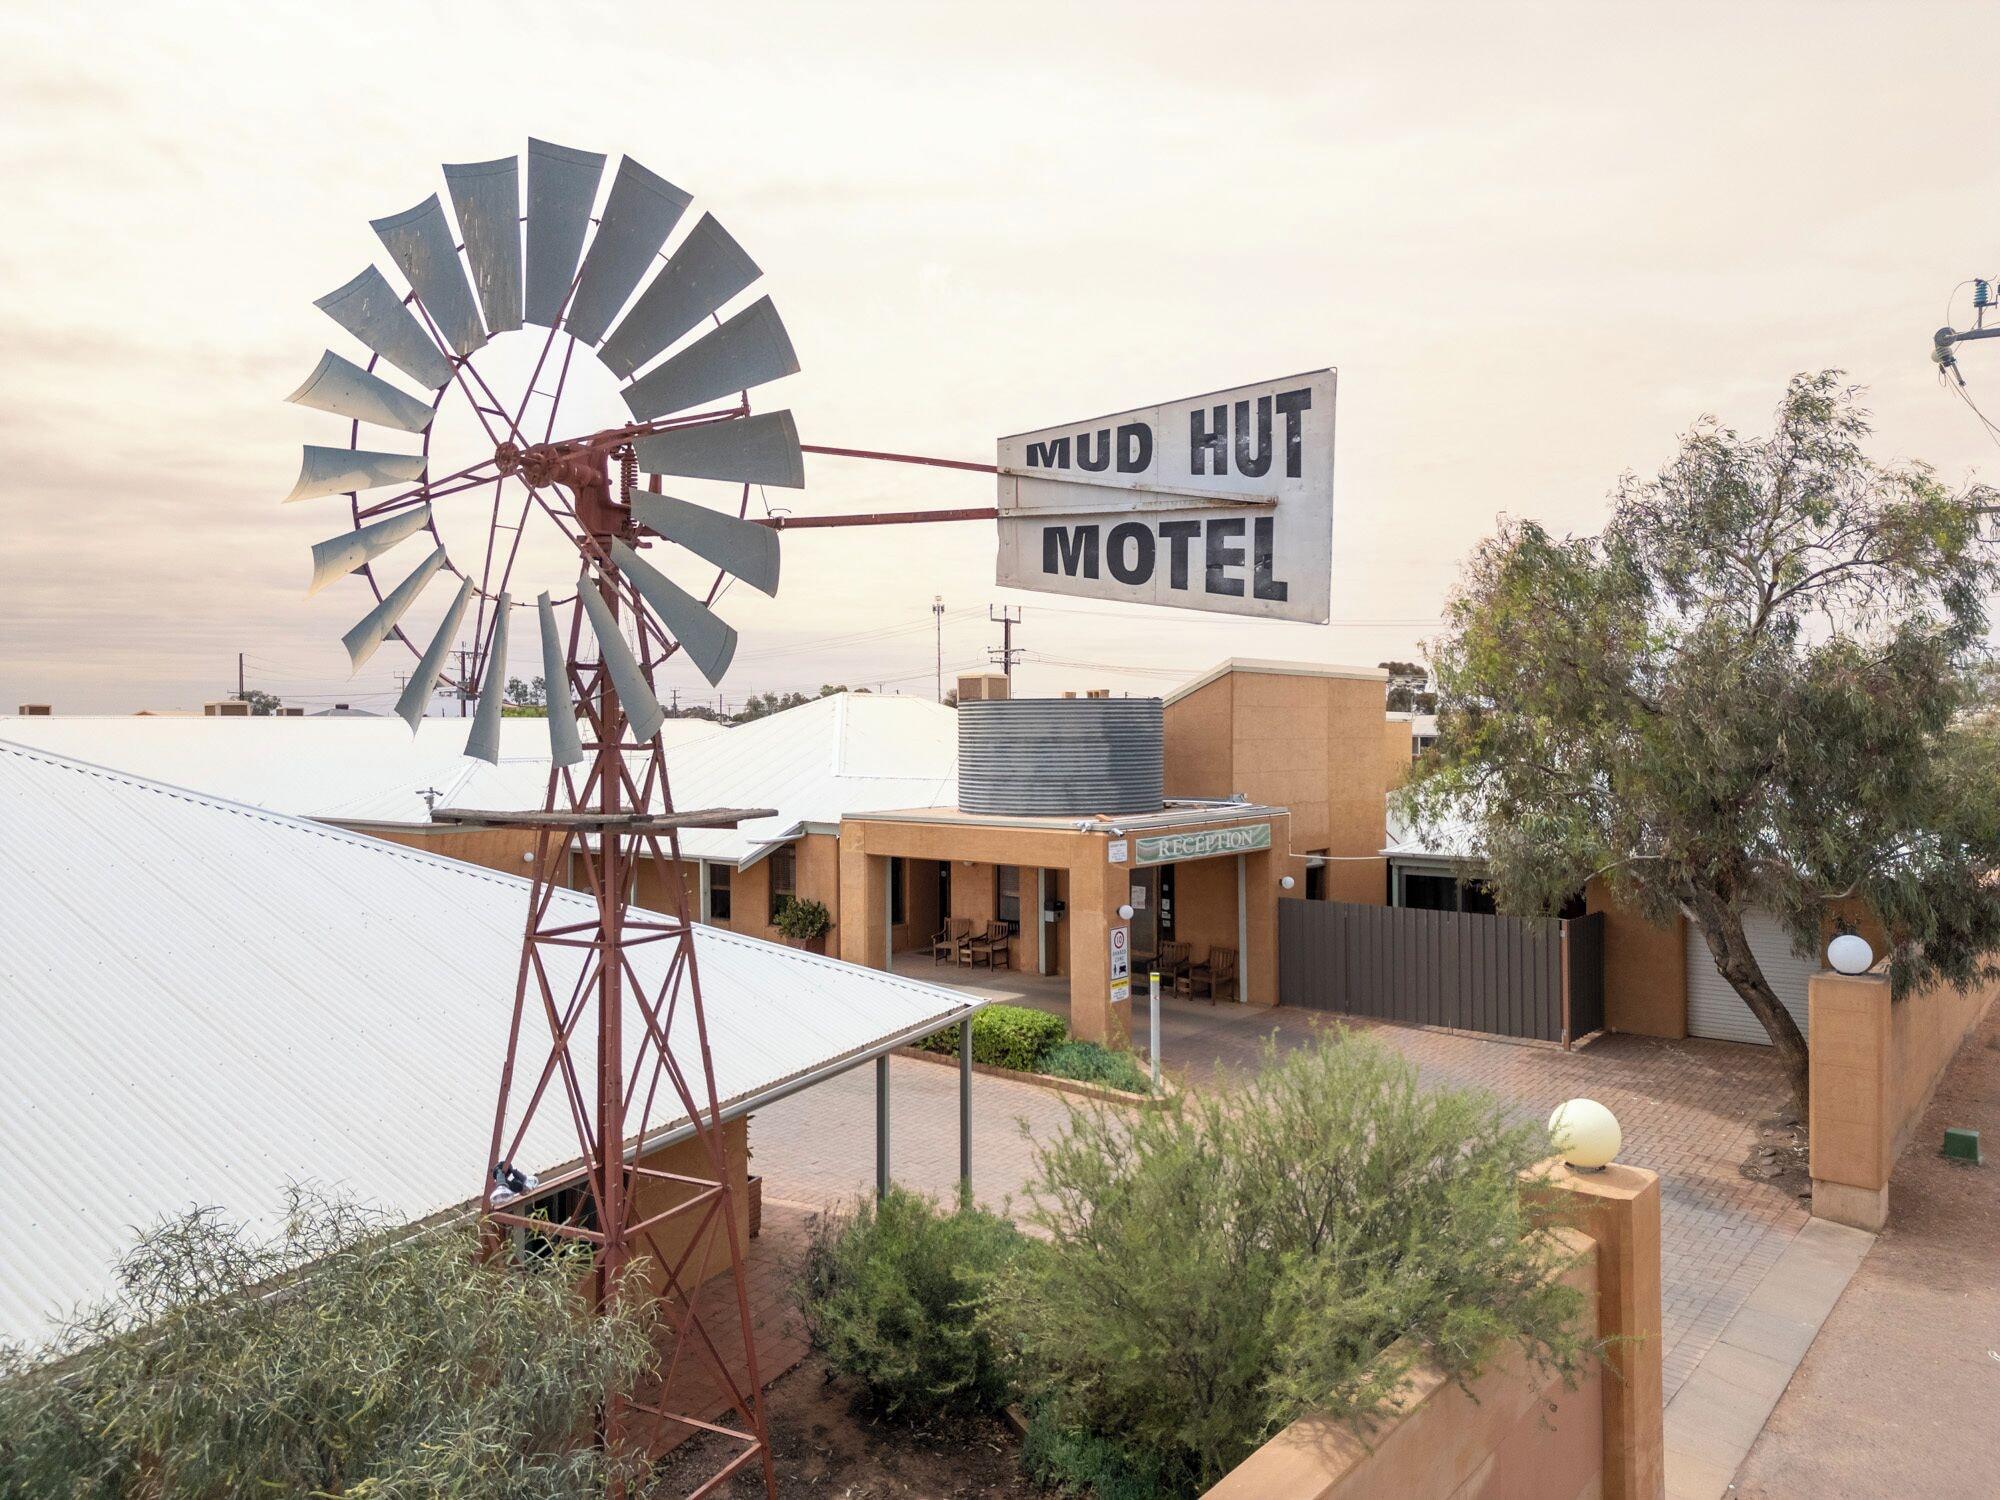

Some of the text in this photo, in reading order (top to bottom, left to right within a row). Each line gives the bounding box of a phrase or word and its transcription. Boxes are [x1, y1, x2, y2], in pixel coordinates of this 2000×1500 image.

[1026, 387, 1311, 478] MUD HUT
[1042, 517, 1288, 602] MOTEL
[1158, 830, 1253, 857] RECEPTION
